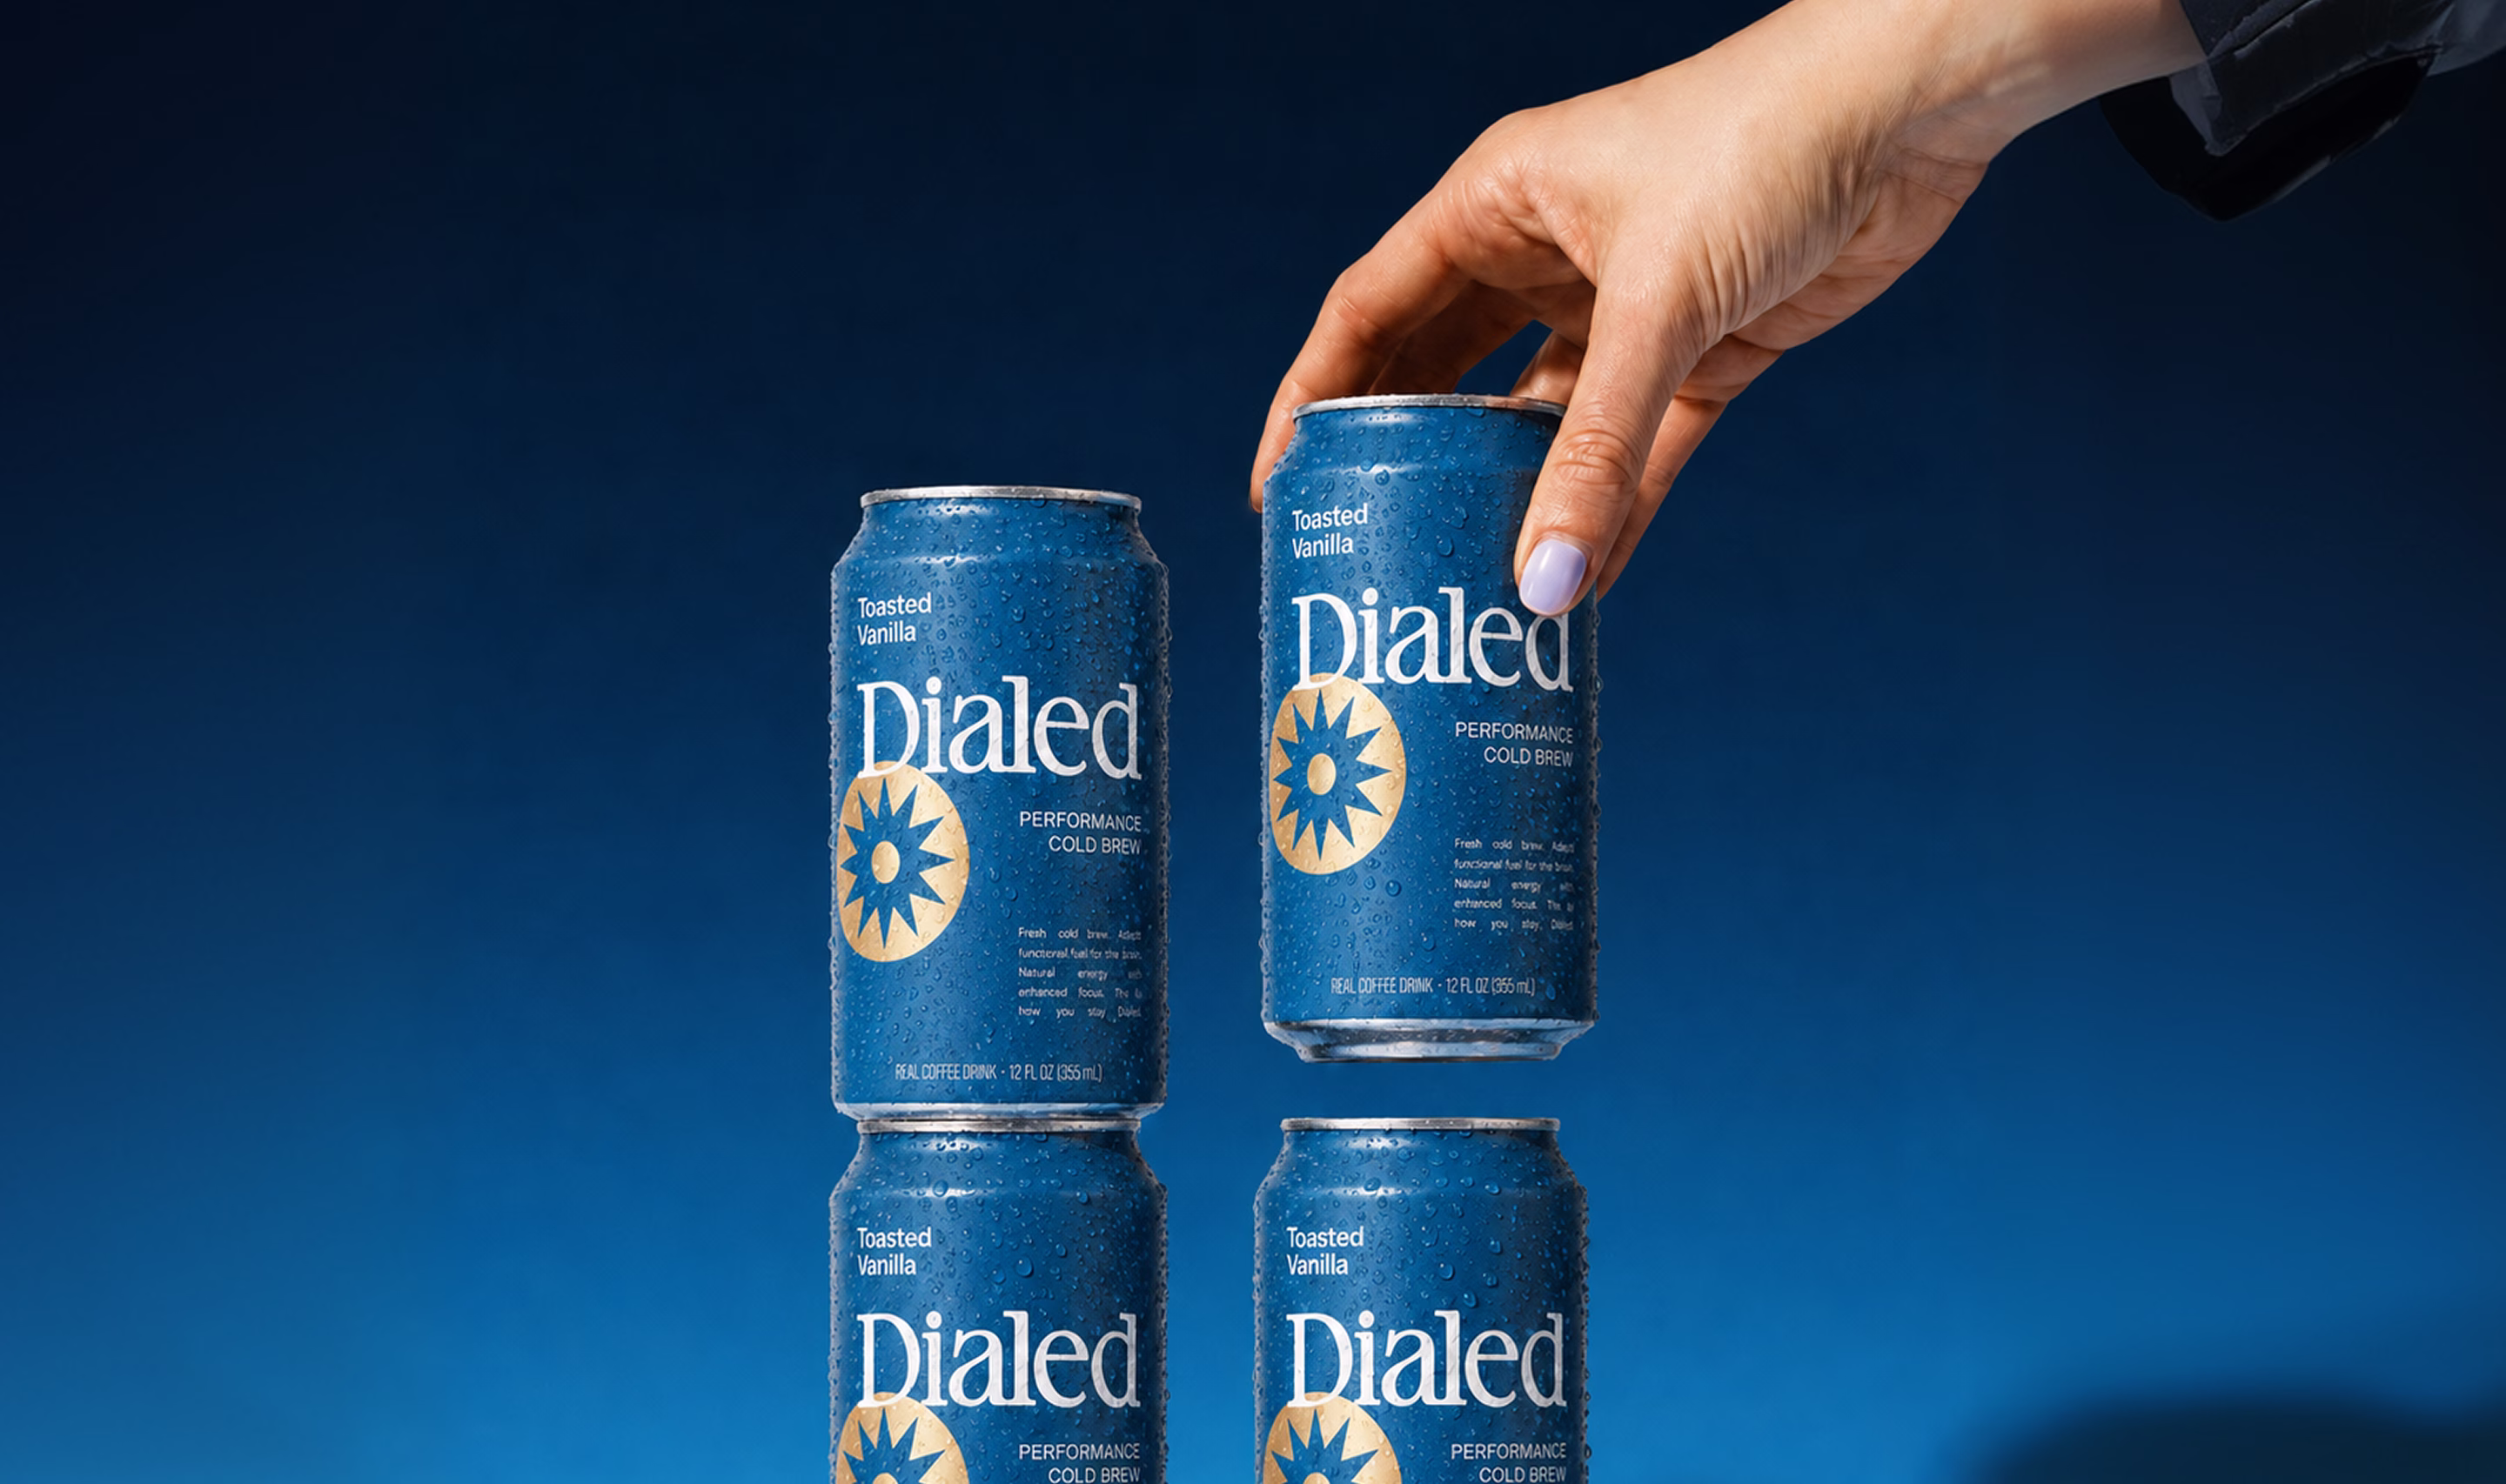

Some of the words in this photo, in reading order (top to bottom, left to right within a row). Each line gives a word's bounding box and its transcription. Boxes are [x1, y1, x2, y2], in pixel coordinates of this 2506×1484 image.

[1292, 503, 1368, 532] Toasted
[1292, 533, 1354, 559] Vanilla
[857, 592, 932, 618] Toasted
[857, 620, 916, 646] Vanilla
[1292, 586, 1573, 692] Dialed
[857, 675, 1142, 780] Dialed
[1455, 721, 1573, 745] PERFORMANCE
[1484, 746, 1531, 765] COLD
[1535, 749, 1574, 768] BREW
[1020, 811, 1142, 832] PERFORMANCE
[1049, 835, 1097, 852] COLD
[1102, 837, 1142, 855] BREW
[1455, 838, 1482, 848] Fresh
[1454, 859, 1503, 869] functional
[1454, 878, 1490, 889] Natural
[1454, 898, 1503, 909] enhanced
[1018, 926, 1047, 938] Fresh
[1058, 928, 1079, 939] cold
[1454, 918, 1476, 928] how
[1491, 920, 1509, 931] you
[1089, 947, 1102, 959] for
[1105, 948, 1119, 959] the
[1018, 966, 1055, 978] Natural
[1077, 970, 1109, 981] energy
[1018, 986, 1068, 998] enhanced
[1330, 977, 1356, 993] REAL
[1358, 977, 1396, 993] COFFEE
[1399, 977, 1433, 993] DRINK
[1445, 977, 1457, 993] 12
[1460, 977, 1473, 993] FL
[1475, 977, 1489, 993] OZ
[1018, 1006, 1041, 1016] how
[1055, 1007, 1075, 1019] you
[895, 1063, 920, 1080] REAL
[921, 1063, 961, 1080] COFFEE
[962, 1063, 997, 1080] DRINK
[1009, 1063, 1022, 1080] 12
[1024, 1063, 1037, 1080] FL
[1040, 1063, 1054, 1080] OZ
[857, 1227, 932, 1248] Toasted
[1286, 1226, 1364, 1248] Toasted
[857, 1253, 916, 1276] Vanilla
[1286, 1253, 1348, 1275] Vanilla
[856, 1310, 1141, 1408] Dialed
[1286, 1309, 1567, 1408] Dialed
[1019, 1442, 1141, 1460] PERFORMANCE
[1451, 1442, 1567, 1460] PERFORMANCE
[1049, 1467, 1096, 1484] COLD
[1101, 1467, 1141, 1484] BREW
[1479, 1467, 1525, 1484] COLD
[1529, 1466, 1567, 1484] BREW
